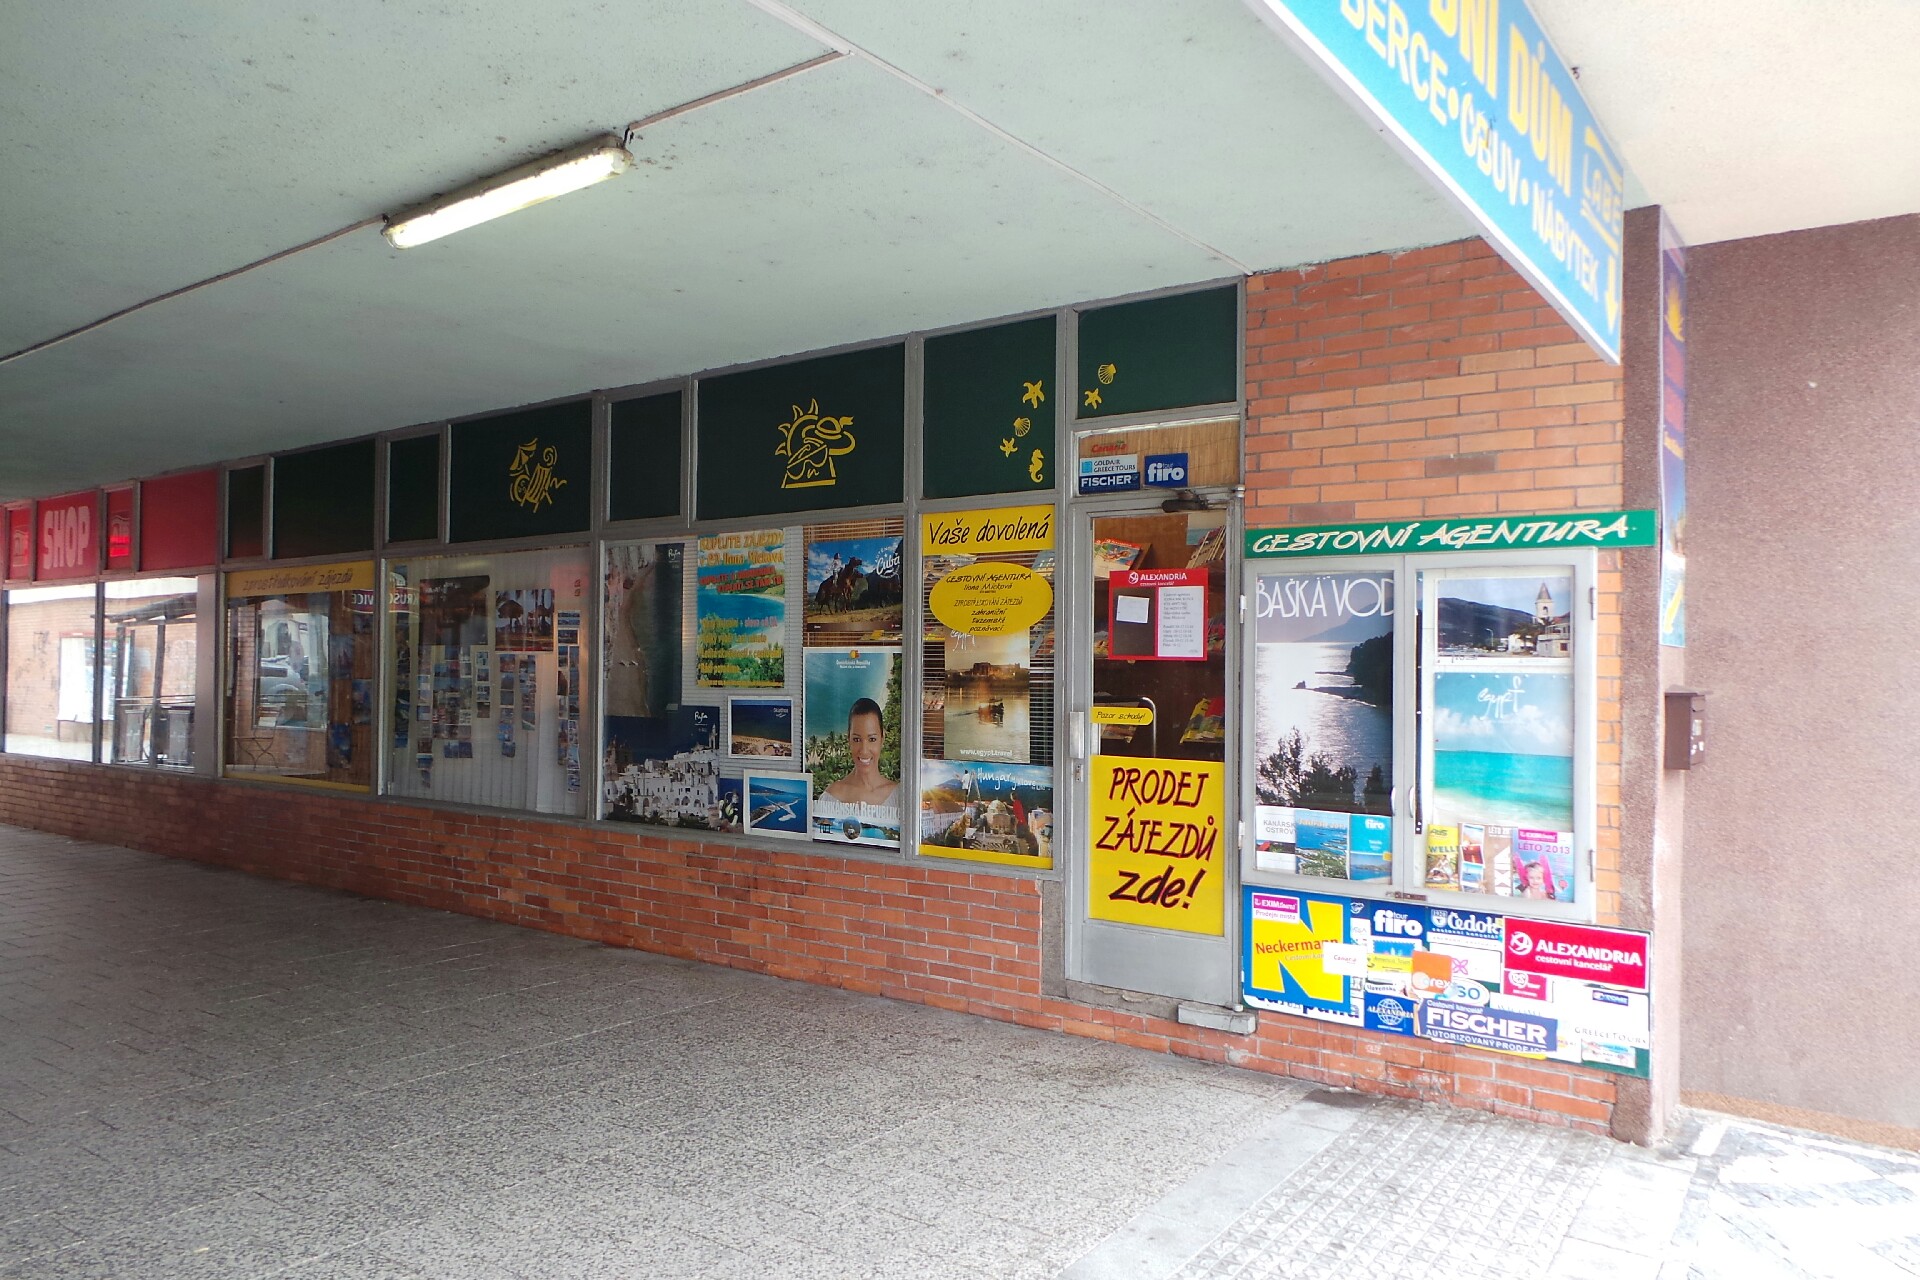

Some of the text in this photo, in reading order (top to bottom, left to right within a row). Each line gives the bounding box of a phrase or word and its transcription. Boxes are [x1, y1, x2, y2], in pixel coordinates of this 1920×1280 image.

[1508, 22, 1573, 198] DŮM
[1532, 180, 1599, 303] NÁBYTEK
[1081, 474, 1131, 488] FISCHER
[1147, 462, 1185, 483] firo
[43, 505, 91, 570] SHOP
[929, 513, 1052, 545] Vaše dovolená
[1252, 514, 1633, 554] CESTOVNÍ AGENTURA
[876, 553, 901, 575] Cuba
[1140, 572, 1187, 581] ALEXANDRIA
[1331, 577, 1395, 617] VOD
[1109, 767, 1209, 808] PRODEJ
[1095, 807, 1218, 862] ZÁJEZDŮ
[1546, 844, 1570, 855] 2013
[1108, 864, 1206, 909] zde!
[1373, 909, 1423, 936] firo
[1255, 939, 1339, 954] Neckerma
[1536, 939, 1643, 967] ALEXANDRIA
[1535, 955, 1613, 972] cestovní kancelář
[1427, 1007, 1547, 1044] FISCHER
